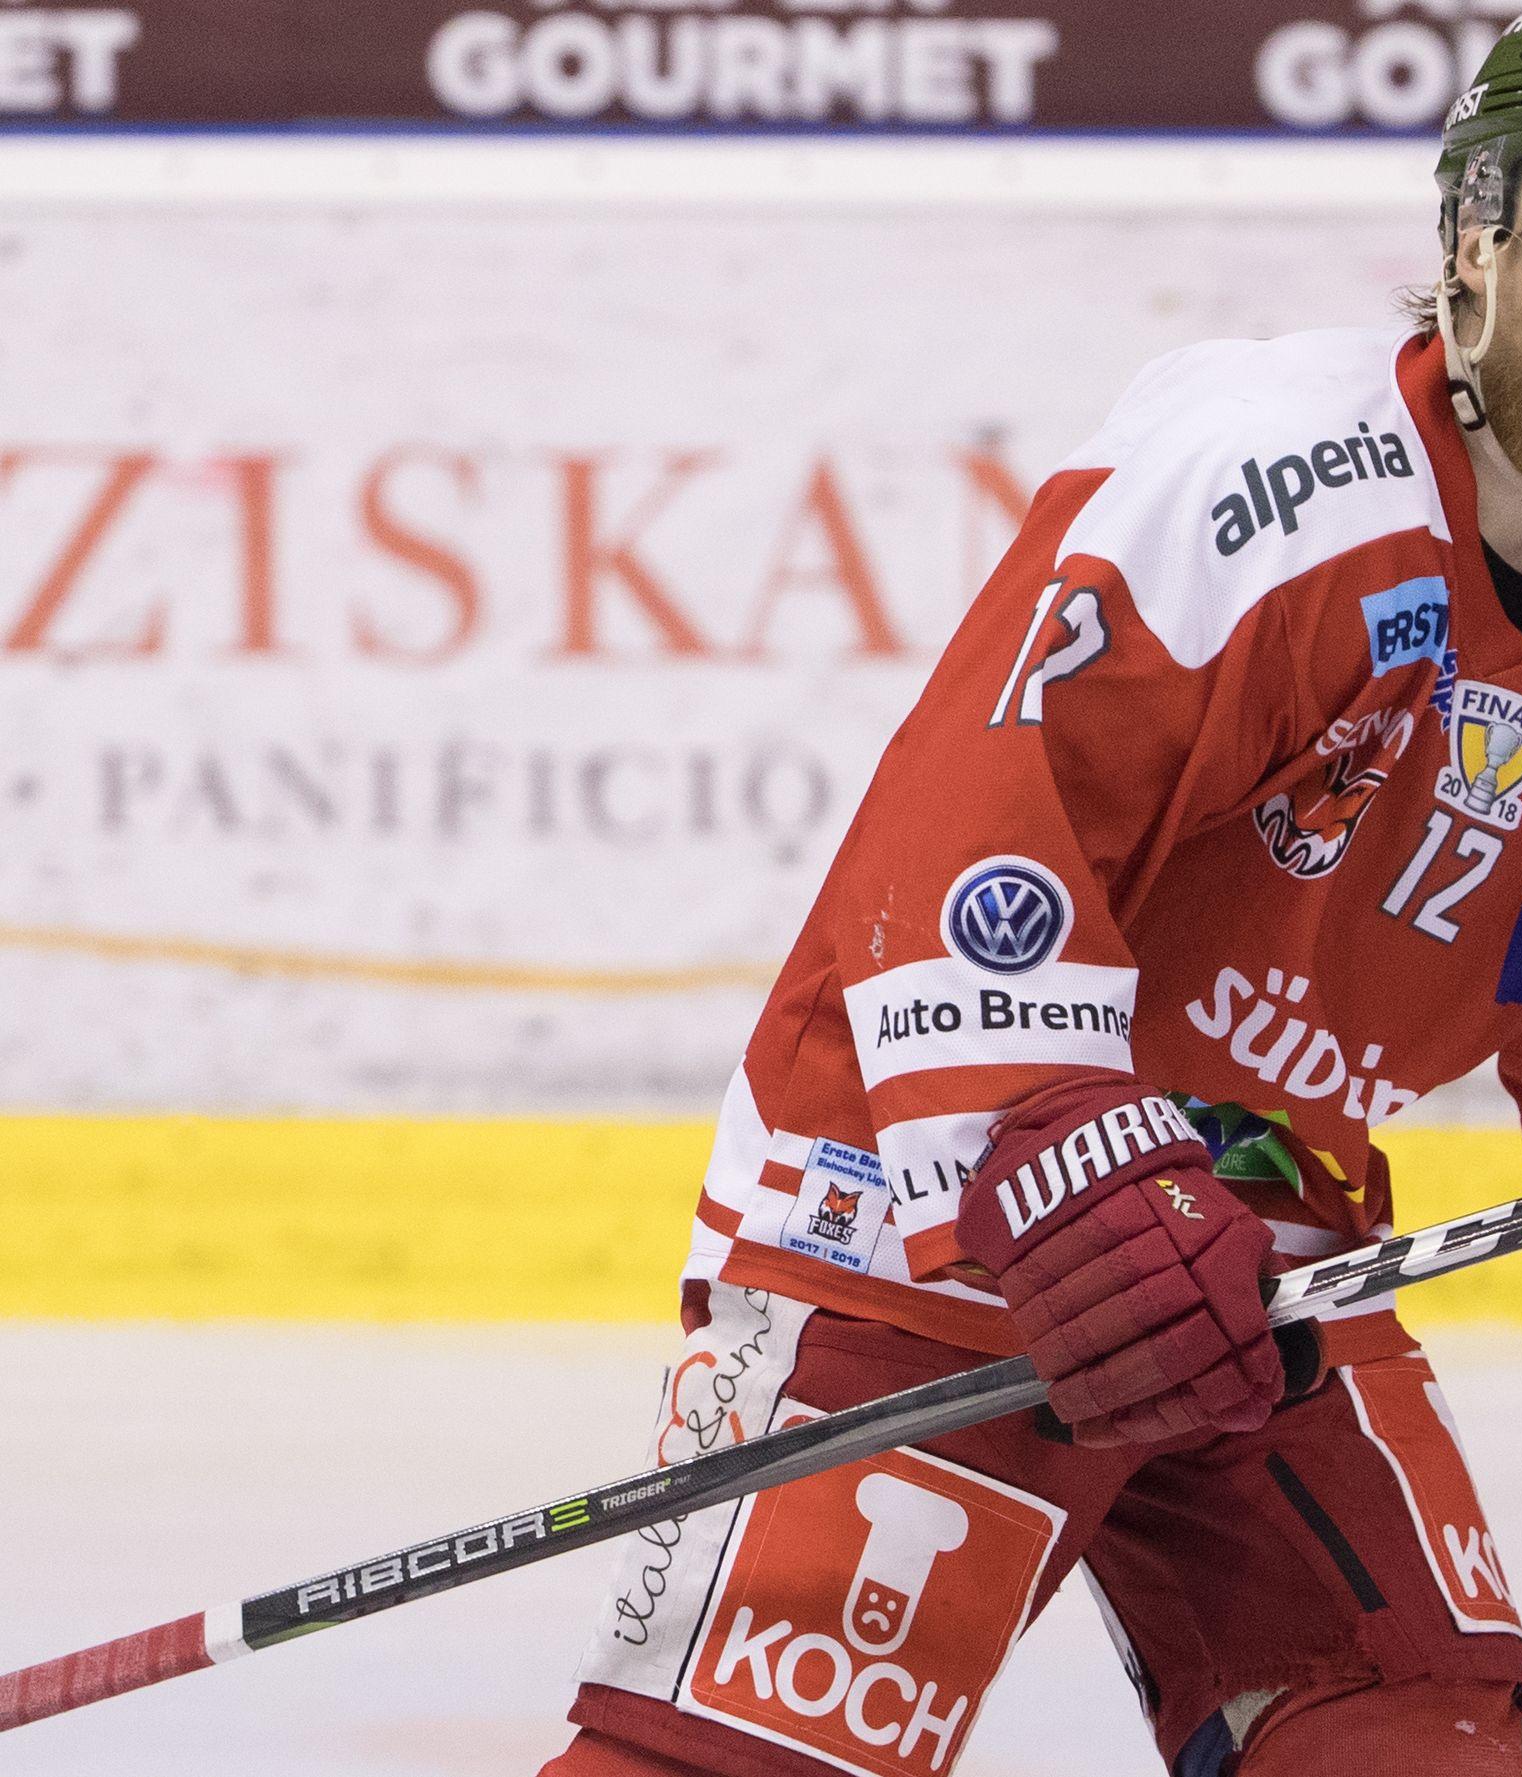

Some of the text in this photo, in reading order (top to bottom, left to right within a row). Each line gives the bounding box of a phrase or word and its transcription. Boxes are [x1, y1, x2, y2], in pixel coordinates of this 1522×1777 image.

[425, 12, 1057, 120] GOURMET
[1211, 421, 1415, 557] alperia
[986, 577, 1111, 729] 12
[97, 735, 835, 845] PANIFICIO
[1440, 773, 1518, 823] 20 18
[1379, 808, 1504, 944] 12
[876, 989, 1133, 1049] Auto Brenne
[789, 1238, 861, 1268] 2017 2018
[807, 1214, 858, 1246] FOXES
[713, 1605, 969, 1772] KOCH
